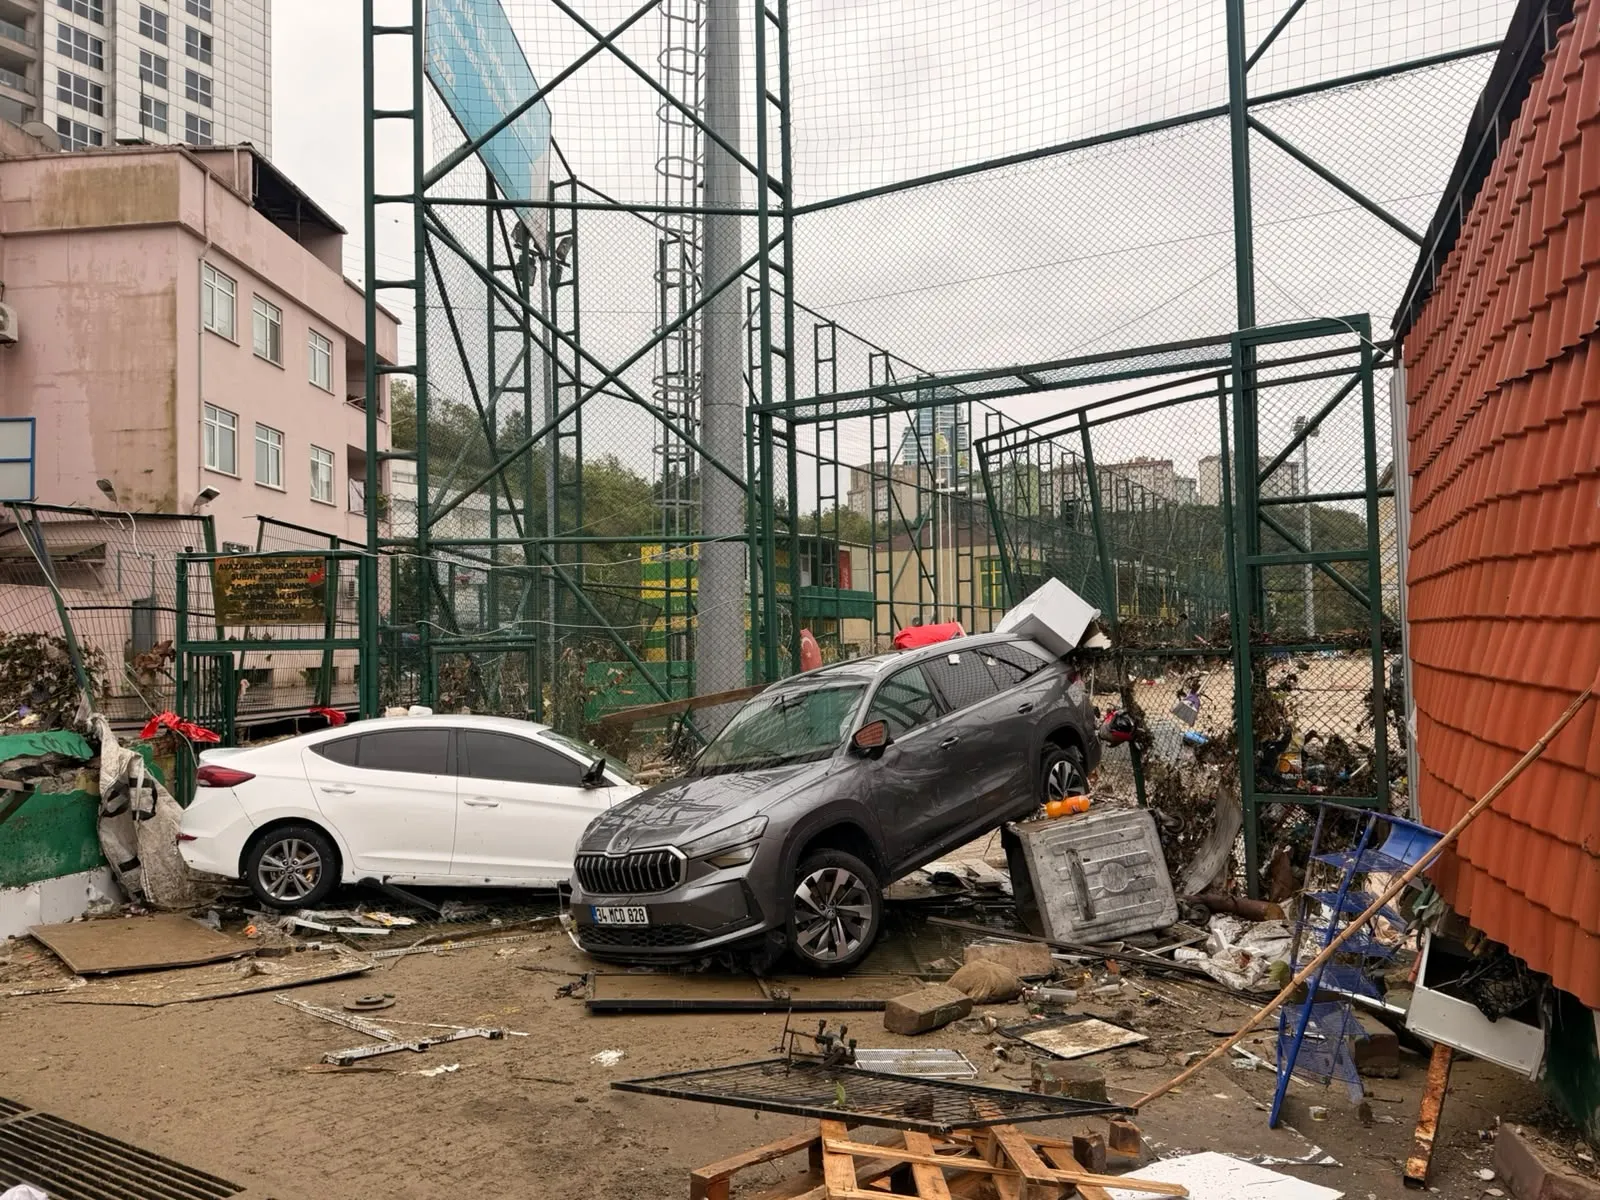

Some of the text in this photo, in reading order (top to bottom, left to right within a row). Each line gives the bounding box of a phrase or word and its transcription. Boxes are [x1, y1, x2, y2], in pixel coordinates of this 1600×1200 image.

[596, 908, 646, 923] 34 MCD 828
